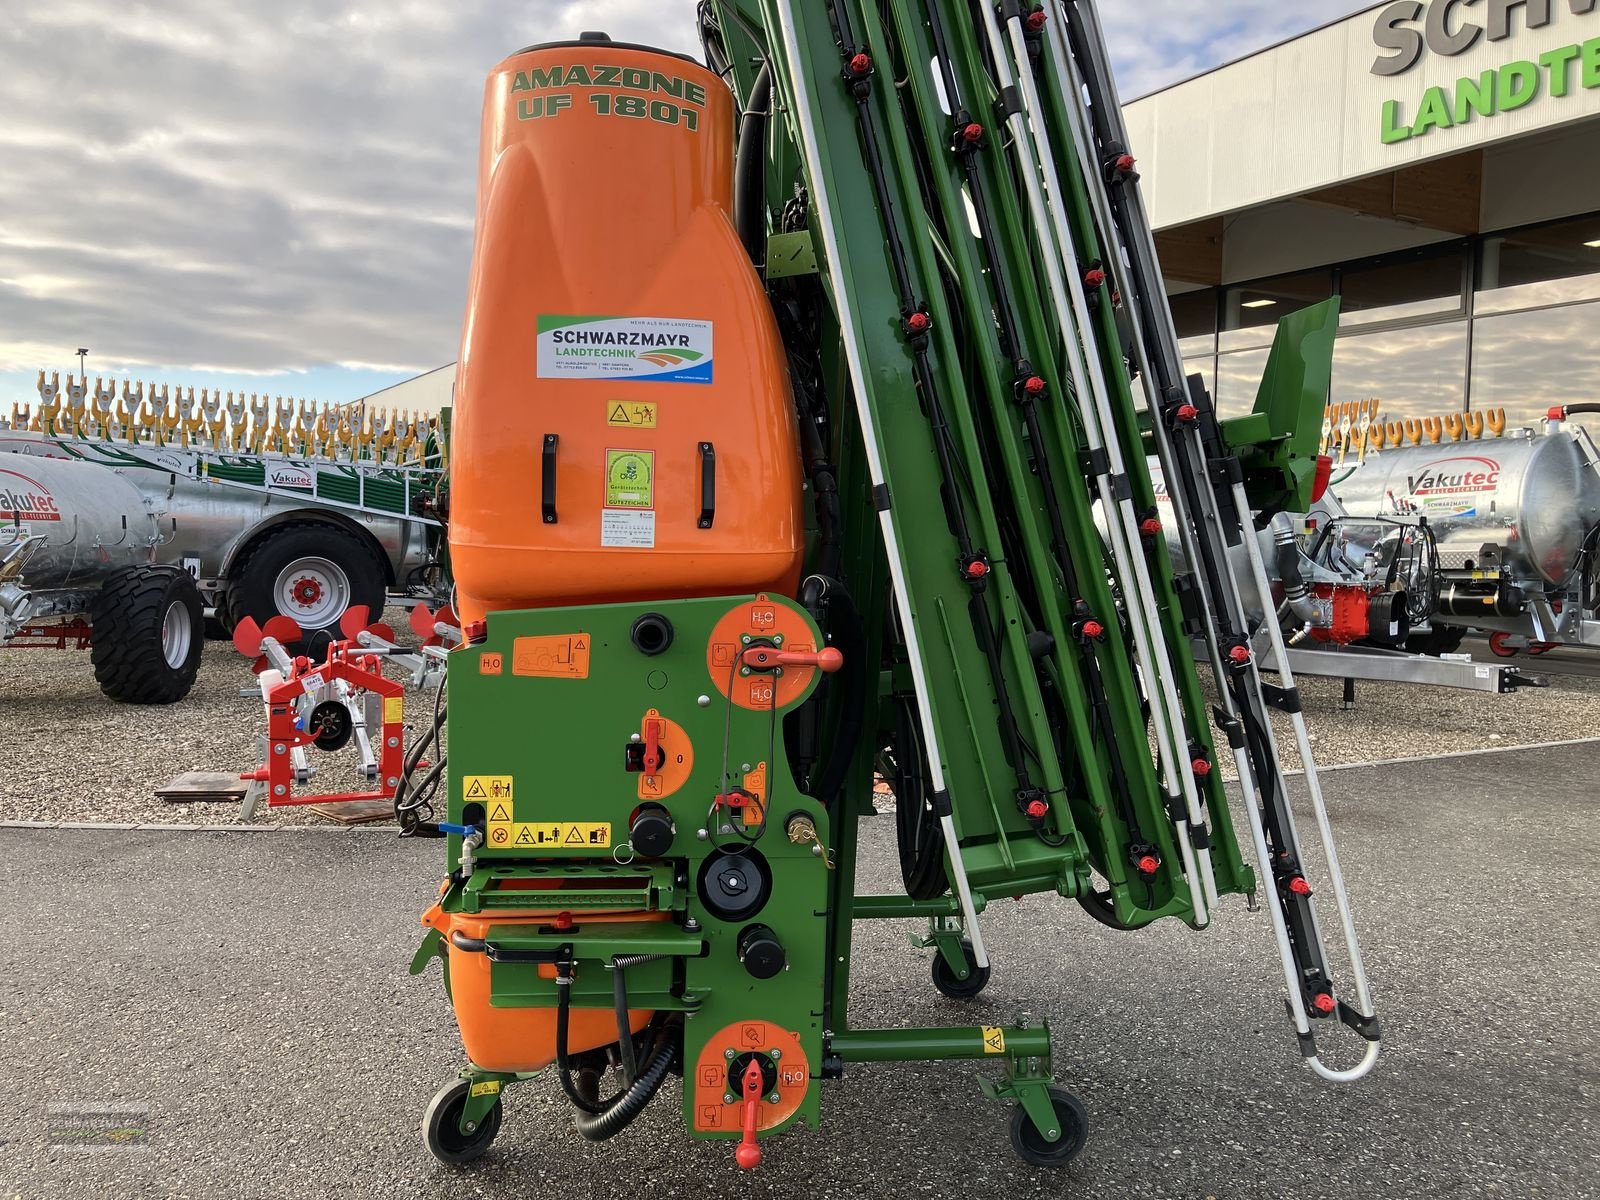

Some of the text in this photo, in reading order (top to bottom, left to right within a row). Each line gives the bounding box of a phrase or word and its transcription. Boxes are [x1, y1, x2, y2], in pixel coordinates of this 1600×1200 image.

[1370, 0, 1596, 76] SCH
[510, 64, 706, 108] AMAZONE
[516, 93, 699, 132] UF 1801
[552, 330, 690, 347] SCHWARZMAYR
[555, 347, 637, 358] LANDTECHNIK
[271, 472, 312, 484] Vakutec
[1407, 469, 1500, 495] Vakutec
[676, 754, 684, 764] 0
